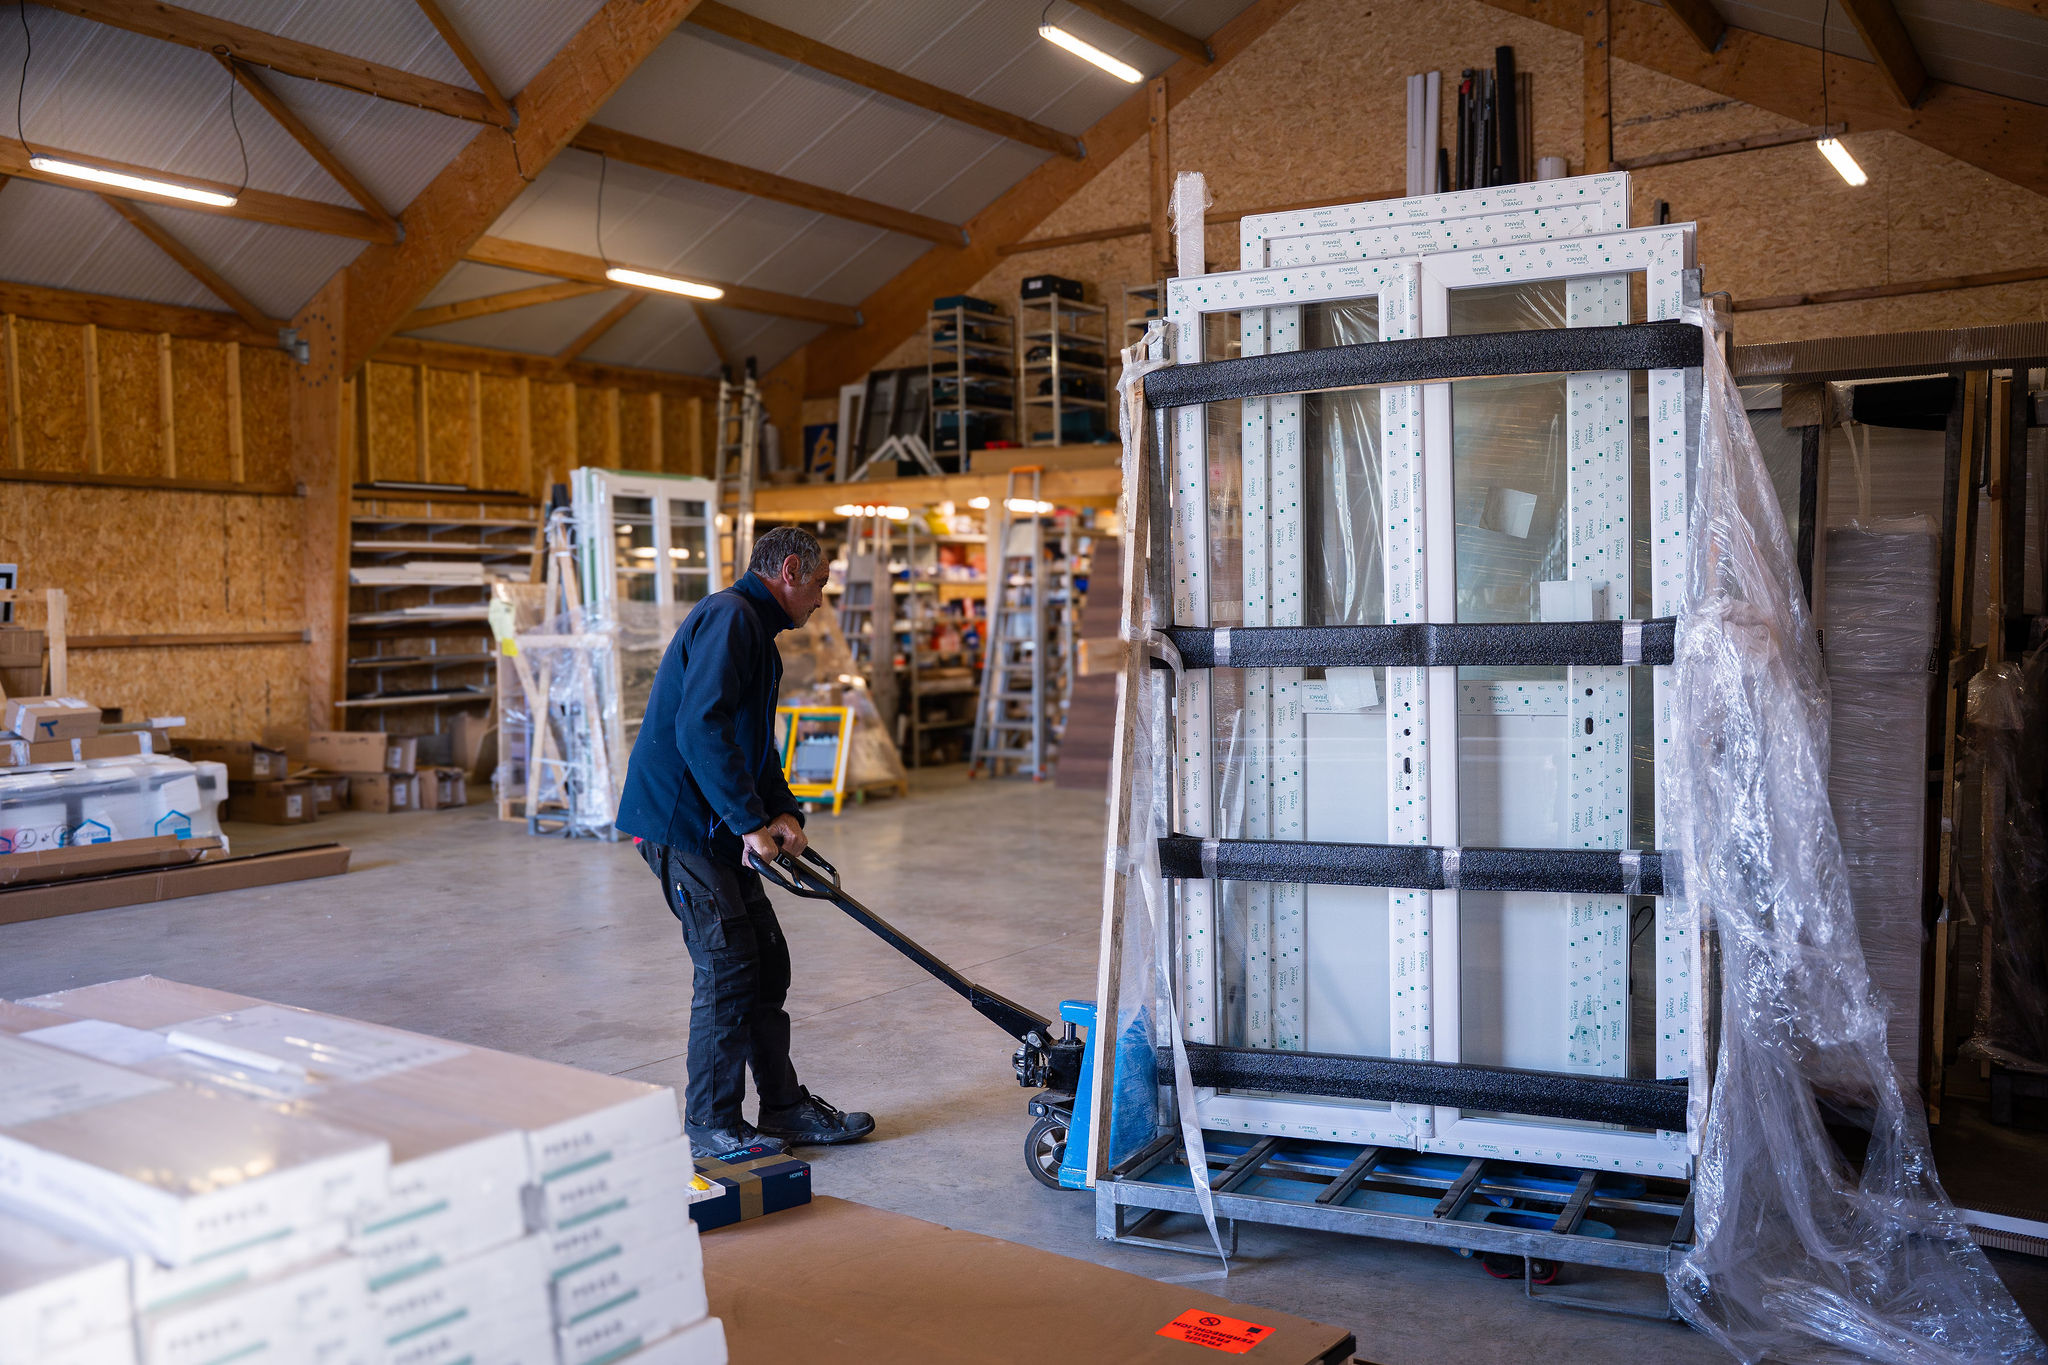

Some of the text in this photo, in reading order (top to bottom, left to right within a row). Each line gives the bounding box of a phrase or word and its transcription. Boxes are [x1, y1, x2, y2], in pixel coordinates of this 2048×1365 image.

[719, 1150, 750, 1160] HOPPE
[790, 1171, 803, 1179] HOPPE
[1184, 1330, 1231, 1344] FRAGILE
